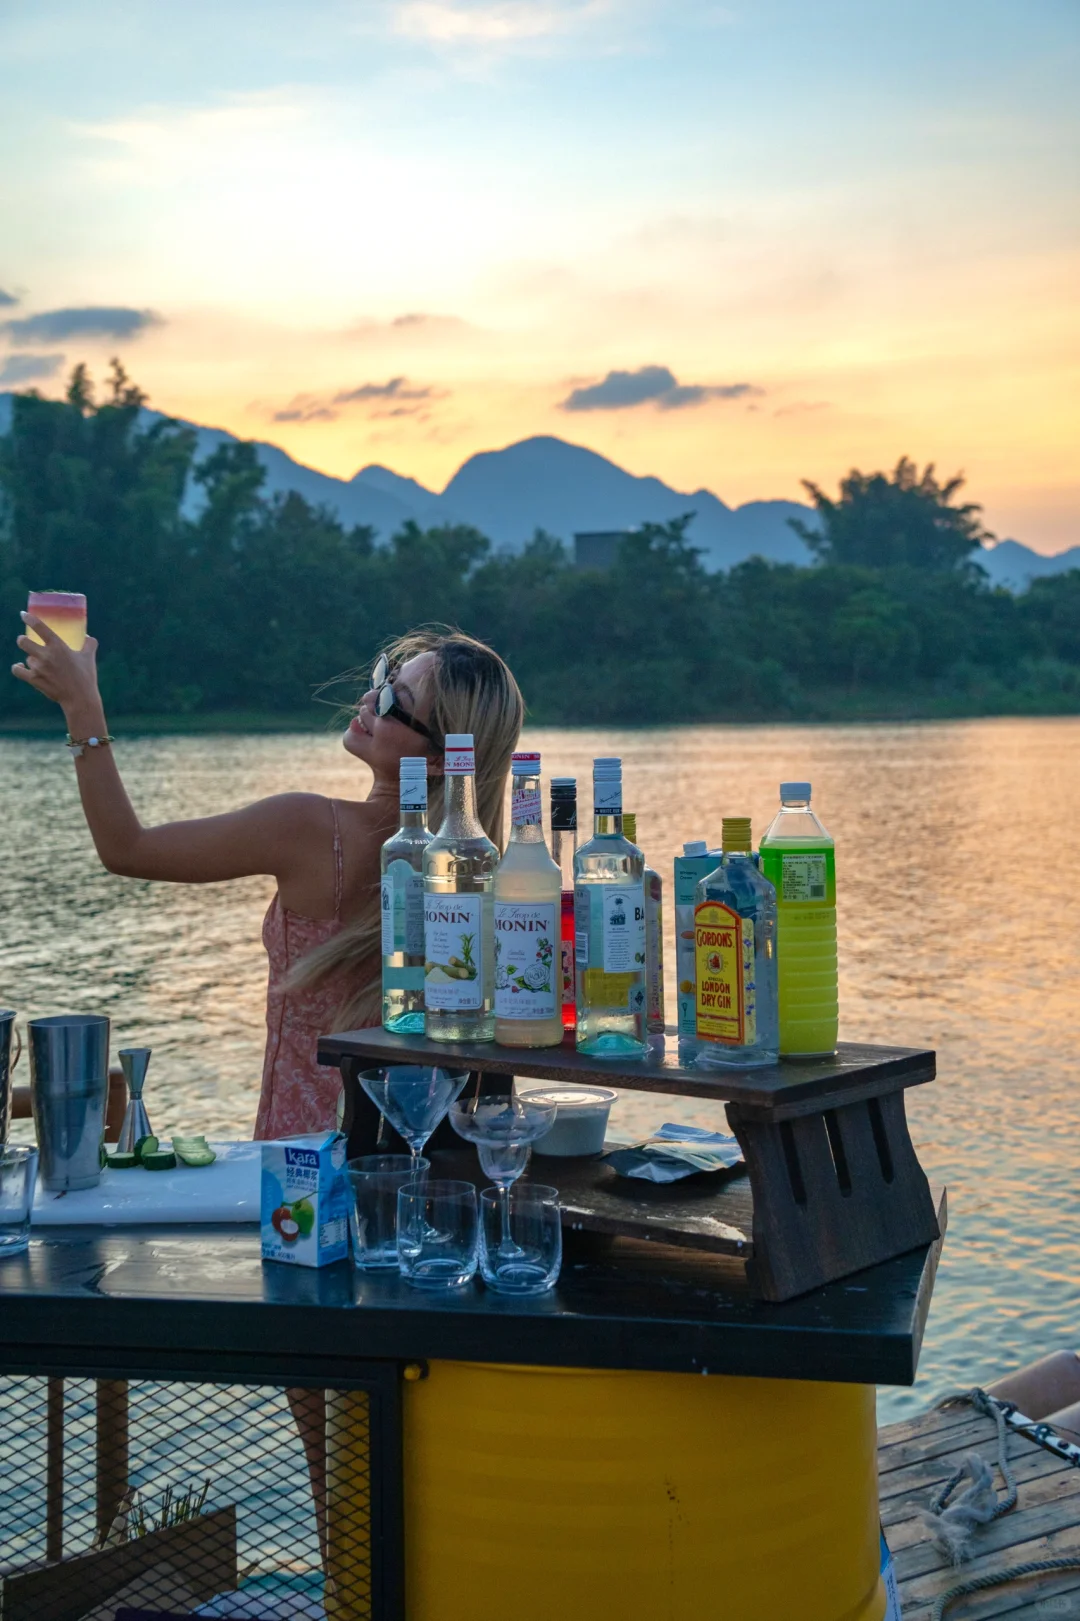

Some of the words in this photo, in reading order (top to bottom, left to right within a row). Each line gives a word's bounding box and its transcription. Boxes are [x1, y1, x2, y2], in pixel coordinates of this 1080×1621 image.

[696, 928, 733, 948] GORDON'S
[701, 980, 731, 995] LONDON
[701, 993, 717, 1008] DRY
[717, 995, 731, 1009] GIN
[288, 1148, 317, 1165] kara
